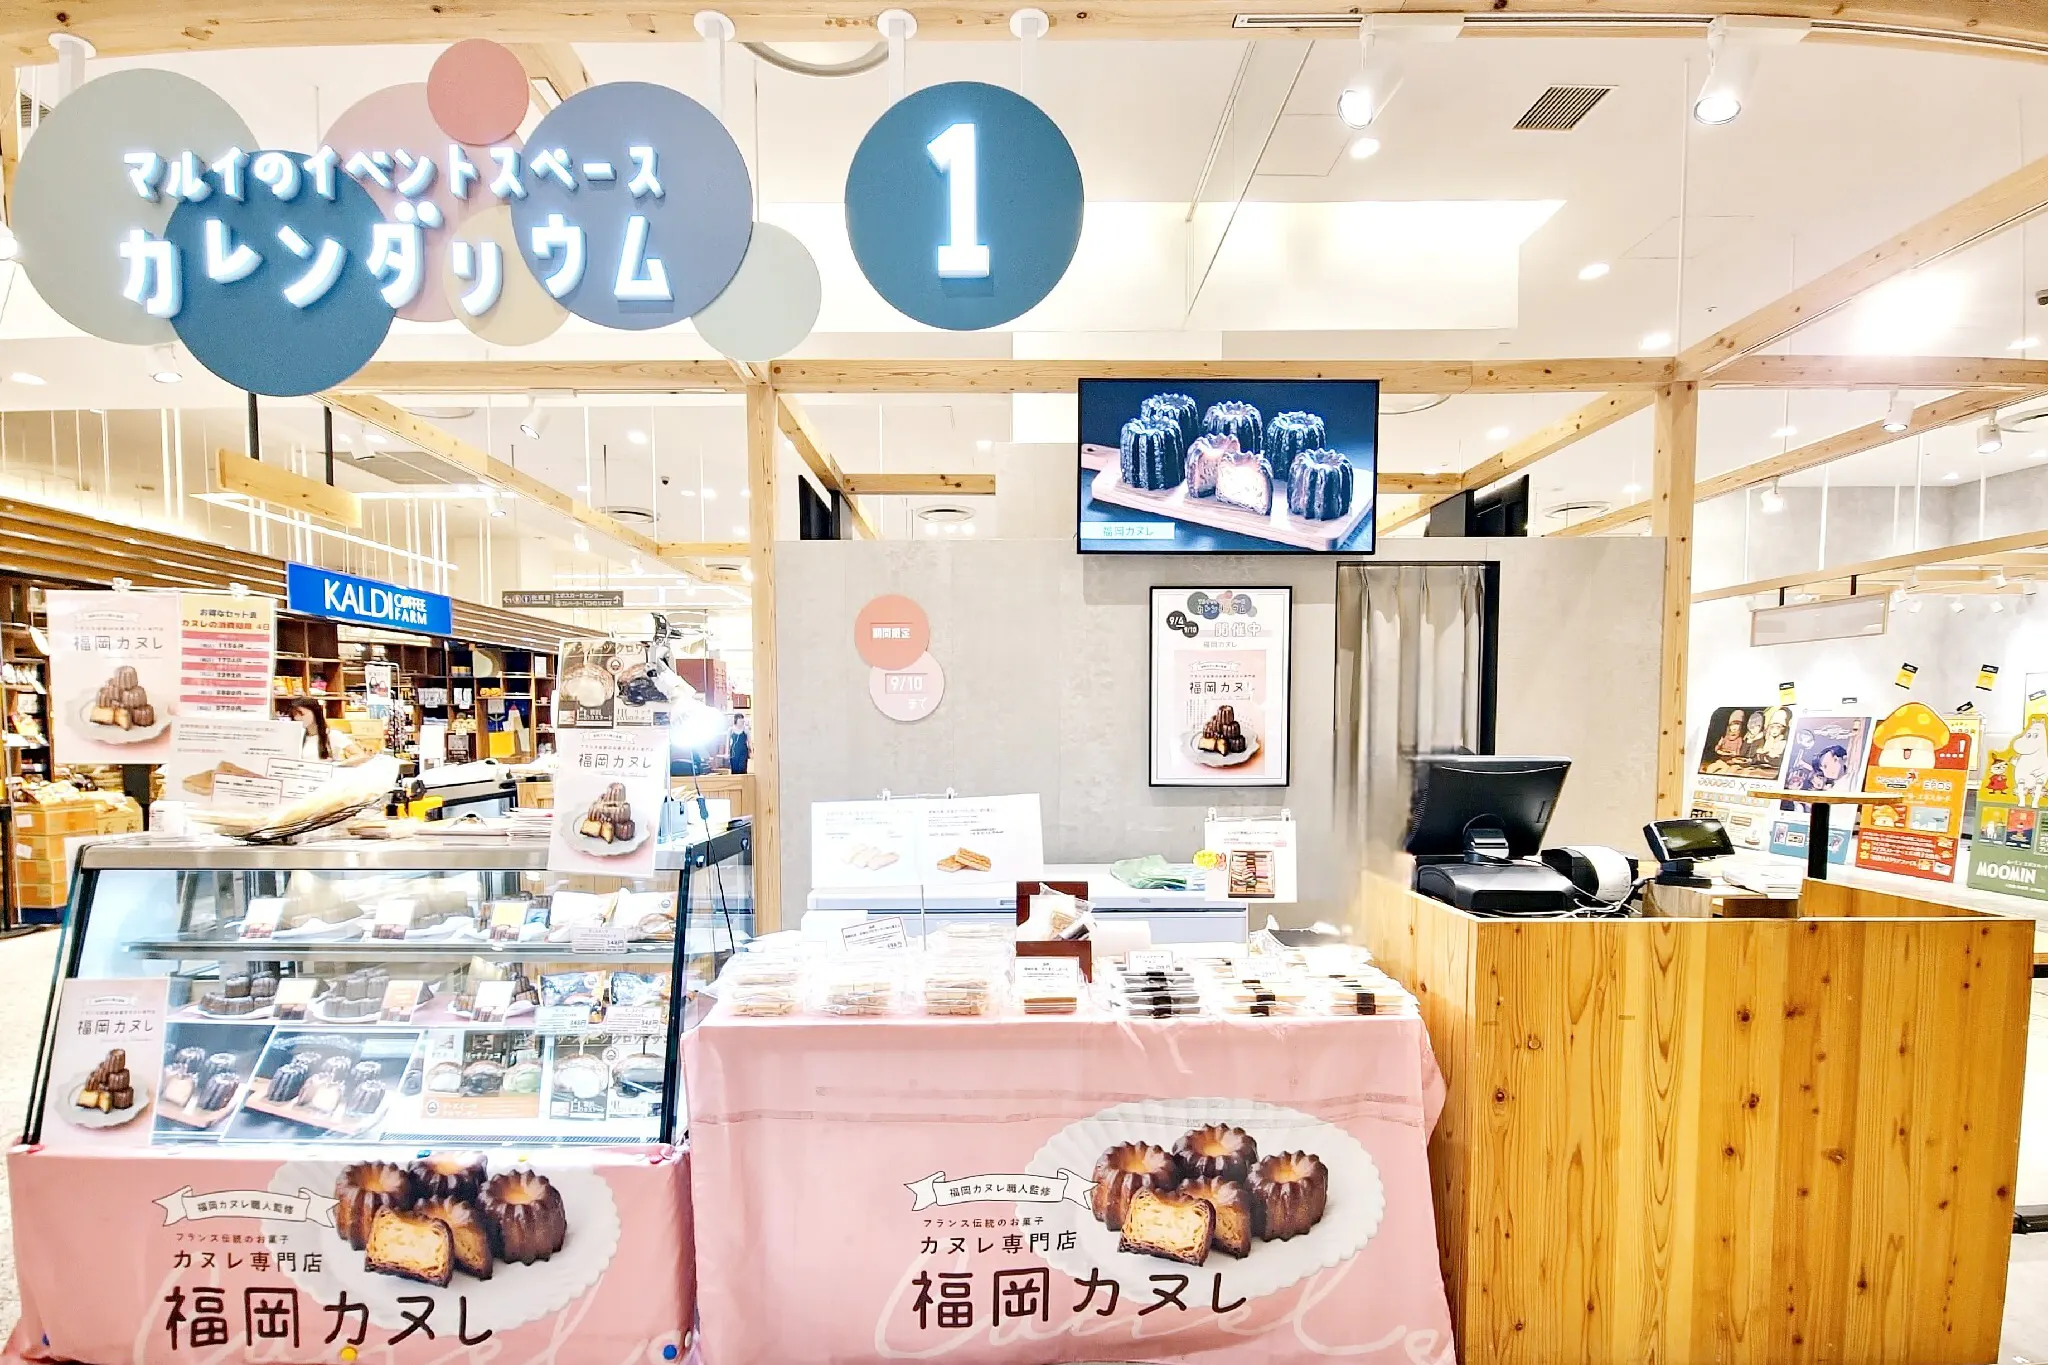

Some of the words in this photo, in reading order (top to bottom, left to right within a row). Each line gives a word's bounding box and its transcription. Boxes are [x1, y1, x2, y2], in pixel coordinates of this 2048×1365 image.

[123, 145, 666, 200] マルイのイベントスペース
[927, 123, 989, 278] 1
[120, 200, 675, 318] カレンダリウム
[1103, 526, 1155, 537] 福岡カヌレ
[324, 578, 394, 620] KALDI
[394, 593, 427, 612] COFFEE
[395, 608, 428, 626] FARM
[1215, 622, 1262, 637] 開催中
[73, 635, 163, 652] 福岡カヌレ
[890, 675, 923, 691] 9/10
[578, 753, 652, 769] 福岡カヌレ
[1976, 861, 2036, 884] MOOMIN
[77, 1019, 154, 1035] 福岡カヌレ
[948, 1183, 1051, 1198] 福岡カヌレ職人監修
[197, 1199, 295, 1215] 福岡カヌレ職人監修
[923, 1216, 1044, 1229] フランス伝統のお菓子
[176, 1233, 289, 1245] フランス伝統のお菓子
[920, 1229, 1078, 1255] カヌレ専門店
[173, 1249, 323, 1273] カヌレ専門店
[911, 1266, 1248, 1330] 福岡カヌレ
[164, 1285, 493, 1350] 福岡カヌレ
